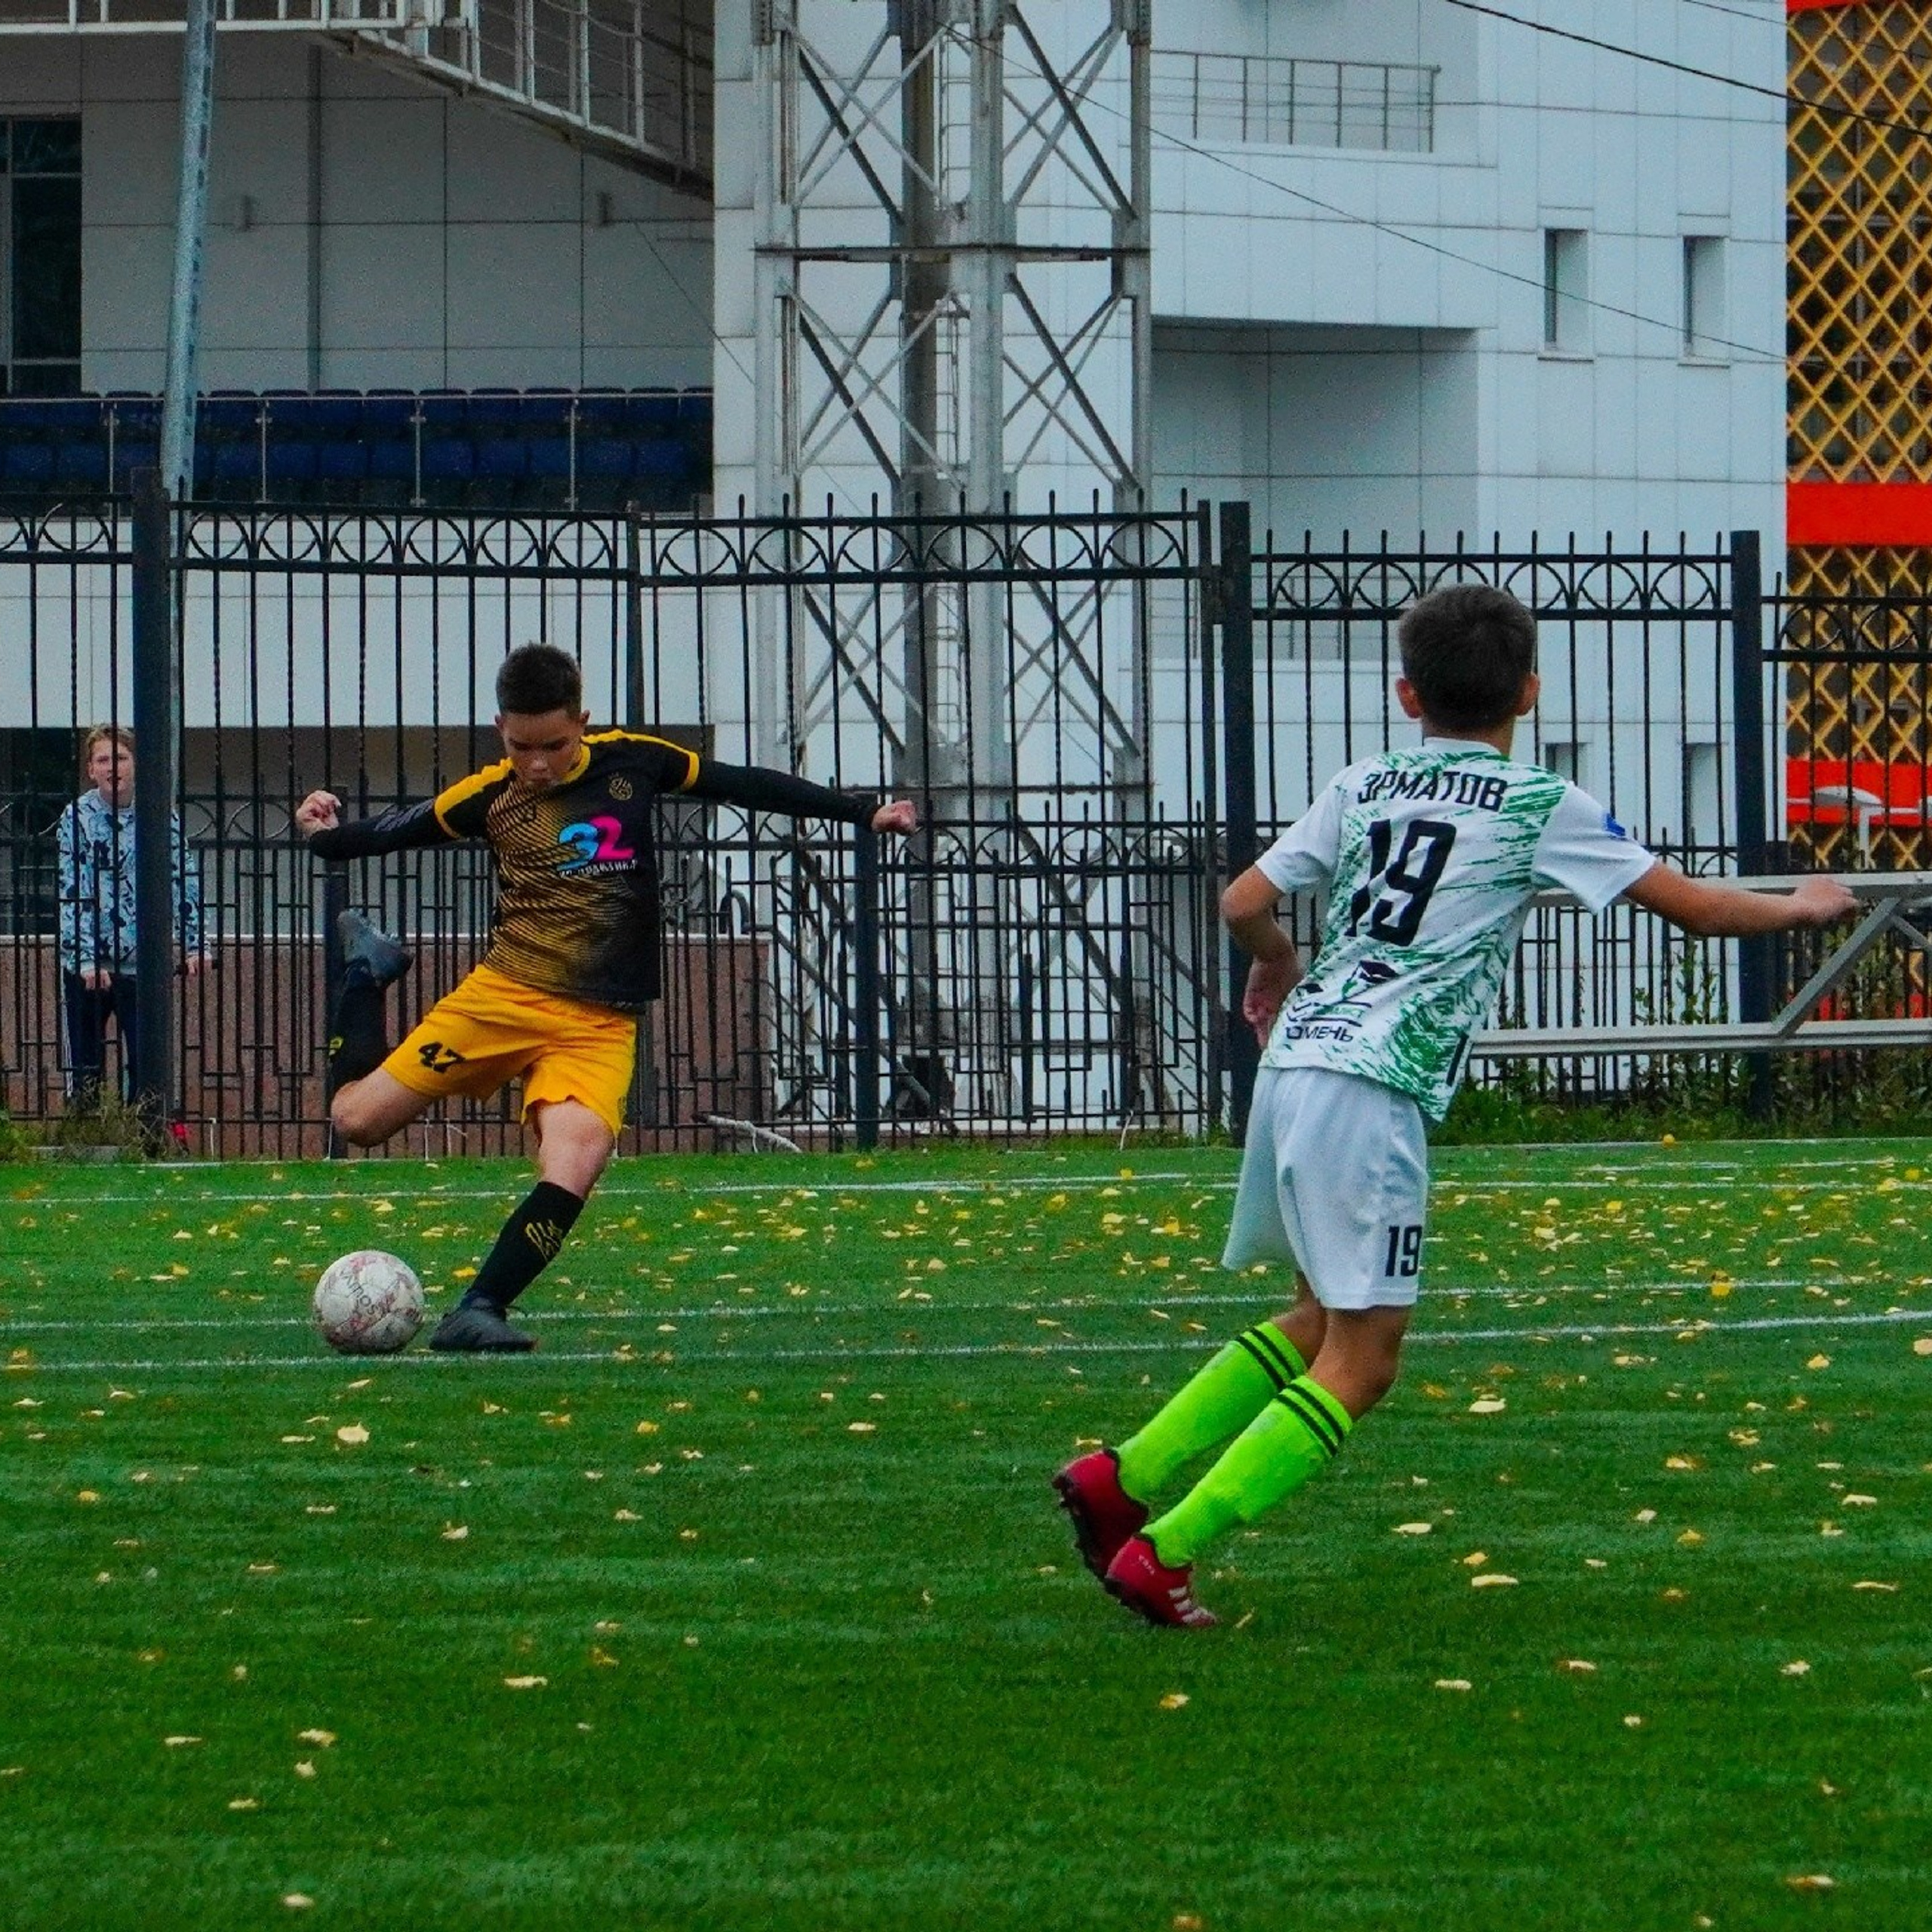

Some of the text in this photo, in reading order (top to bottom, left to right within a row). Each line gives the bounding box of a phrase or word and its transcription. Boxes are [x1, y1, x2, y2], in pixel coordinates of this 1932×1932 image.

[557, 816, 635, 871] 32
[1344, 819, 1457, 946] 19
[419, 1041, 466, 1074] 47
[1385, 1225, 1423, 1277] 19
